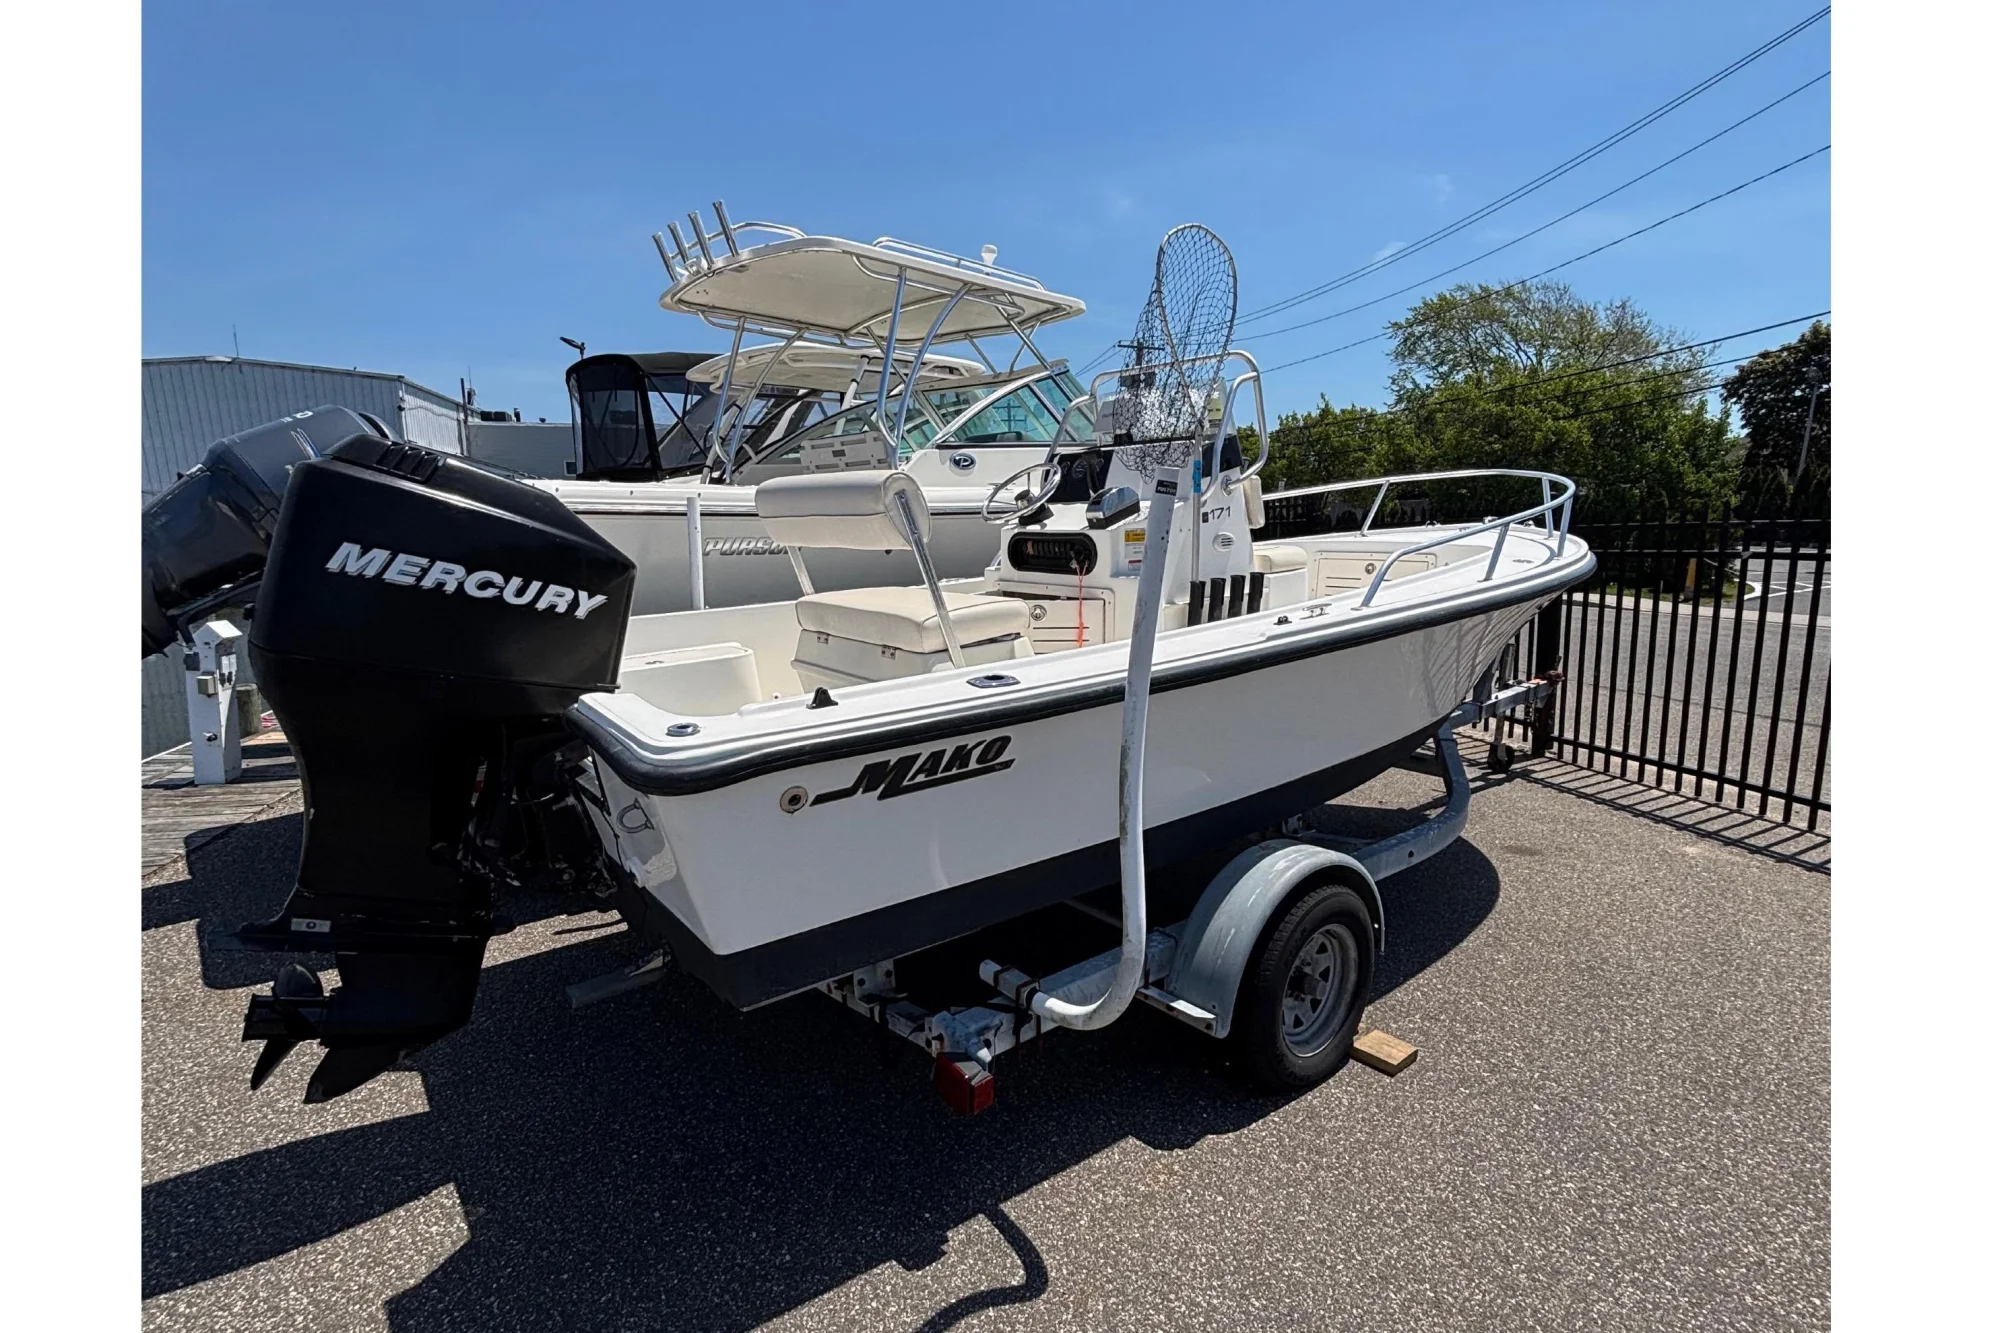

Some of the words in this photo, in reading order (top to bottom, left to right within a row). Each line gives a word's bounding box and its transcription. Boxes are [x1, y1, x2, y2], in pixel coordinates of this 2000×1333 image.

[1209, 506, 1231, 520] 171
[324, 541, 608, 620] MERCURY
[809, 735, 1016, 807] MAKO
